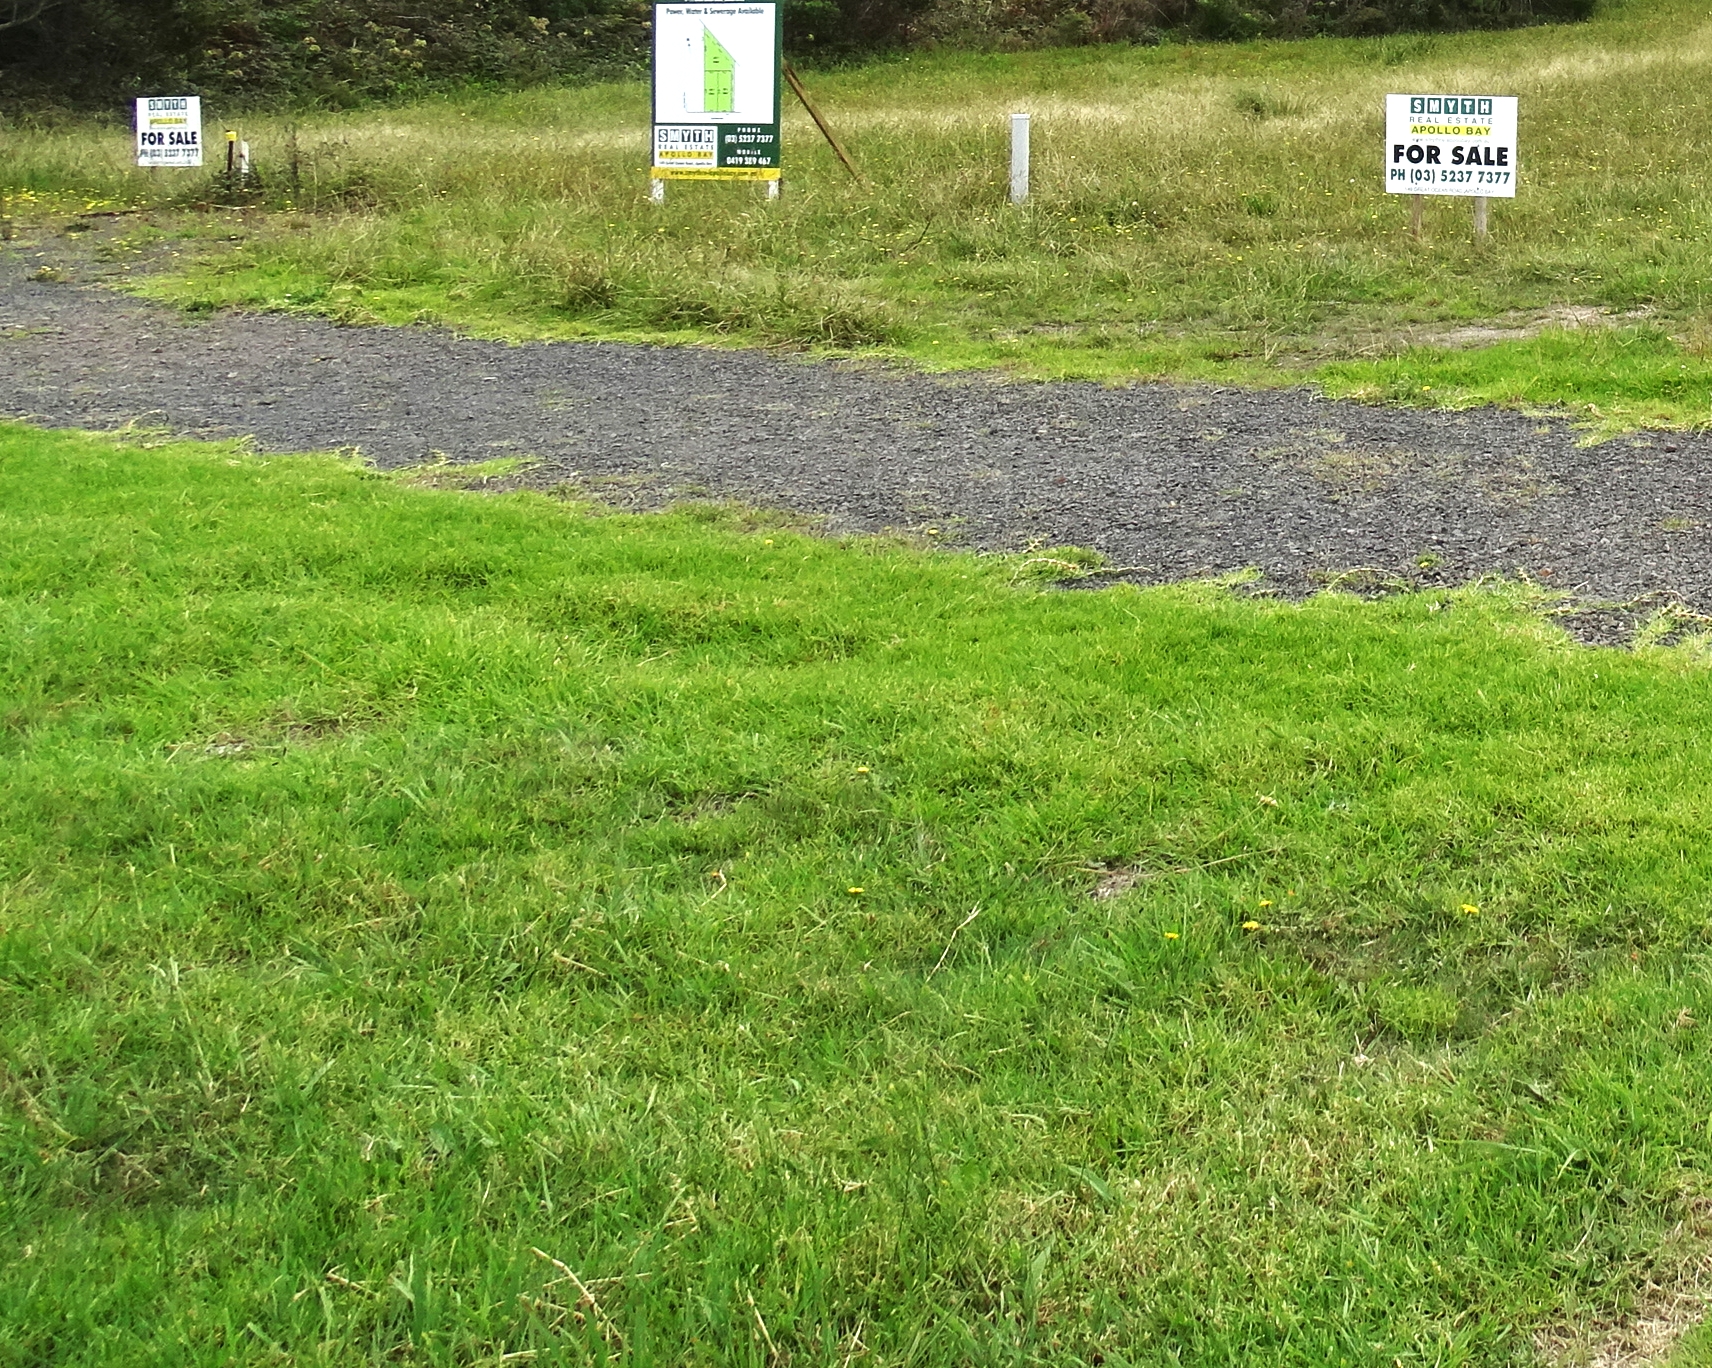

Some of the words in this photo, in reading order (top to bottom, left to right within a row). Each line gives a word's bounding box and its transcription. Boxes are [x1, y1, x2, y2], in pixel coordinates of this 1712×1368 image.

[1411, 97, 1492, 115] SMYTH
[658, 129, 714, 143] SMYTH
[1411, 126, 1460, 135] APOLLO
[1466, 127, 1491, 135] BAY
[141, 132, 165, 145] FOR
[169, 131, 197, 145] SALE
[1394, 144, 1441, 164] FOR
[1451, 145, 1508, 166] SALE
[1391, 169, 1405, 180] PH
[1410, 169, 1435, 184] (03)
[1441, 170, 1473, 182] 5237
[1478, 171, 1510, 184] 7377
